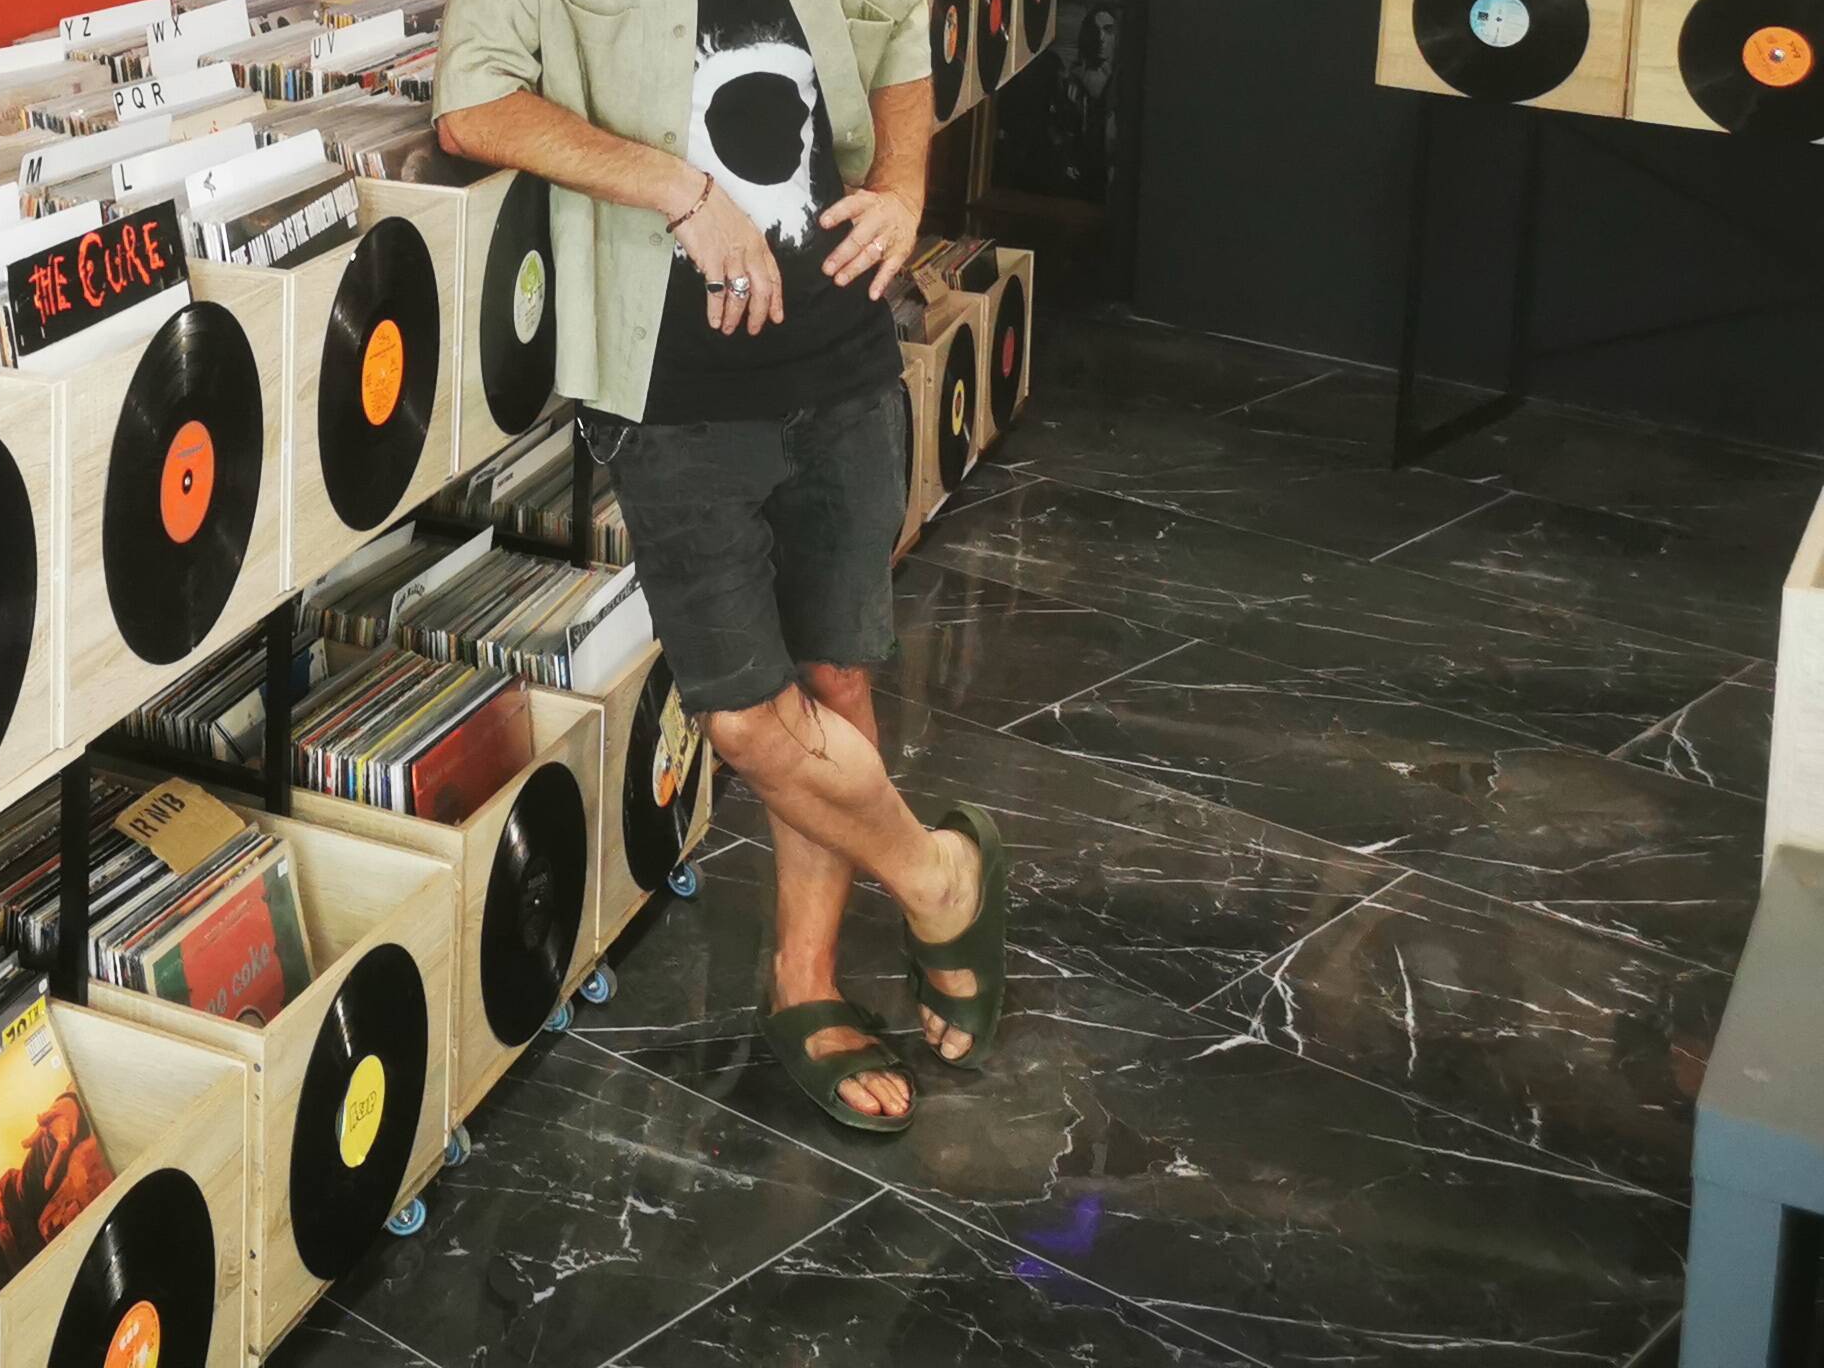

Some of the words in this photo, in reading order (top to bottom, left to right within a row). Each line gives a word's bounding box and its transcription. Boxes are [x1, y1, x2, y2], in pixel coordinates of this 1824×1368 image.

[64, 18, 74, 40] Y
[82, 16, 93, 37] Z
[152, 20, 166, 41] W
[173, 17, 183, 37] X
[313, 39, 322, 59] U
[326, 34, 337, 54] V
[115, 92, 125, 115] P
[132, 90, 147, 111] Q
[151, 82, 165, 105] R
[26, 158, 44, 185] M
[123, 169, 133, 192] L
[28, 262, 72, 325] THE
[78, 220, 166, 309] CURE
